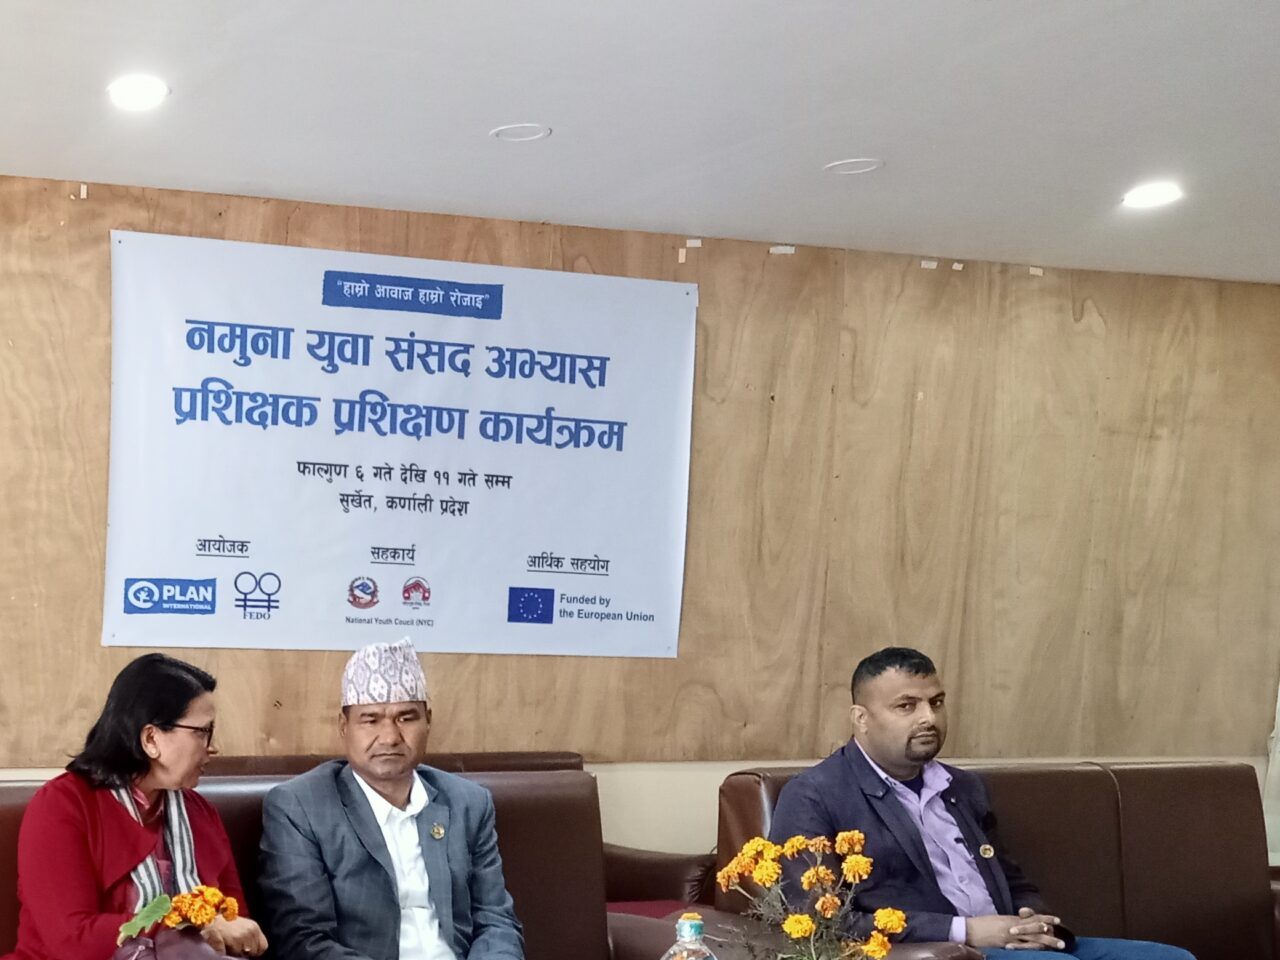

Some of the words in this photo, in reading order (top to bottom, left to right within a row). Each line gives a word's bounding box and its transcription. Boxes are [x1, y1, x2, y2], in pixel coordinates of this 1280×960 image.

[374, 284, 414, 301] आवाज
[419, 287, 445, 305] हाम्रो
[185, 319, 295, 367] नमुना
[306, 329, 374, 374] युवा
[385, 331, 475, 378] संसद
[485, 345, 610, 389] अभ्यास
[172, 376, 321, 430] प्रशिक्षक
[332, 389, 469, 441] प्रशिक्षण
[479, 406, 628, 452] कार्यक्रम
[297, 461, 349, 484] फाल्गुण
[355, 464, 364, 482] ६
[372, 462, 394, 481] गते
[400, 463, 427, 484] देखि
[433, 469, 450, 486] ११
[457, 468, 478, 487] गते
[484, 473, 513, 490] सम्म
[385, 493, 434, 515] कर्णाली
[440, 496, 470, 517] प्रदेश
[196, 535, 251, 554] आयोजक
[370, 544, 416, 562] सहकार्य
[527, 552, 565, 570] आर्थिक
[570, 555, 610, 573] सहयोग
[163, 584, 213, 602] PLAN
[560, 593, 597, 606] Funded
[599, 595, 611, 608] by
[162, 603, 212, 611] INTERNATIONAL
[243, 611, 271, 621] FEDO
[559, 608, 574, 619] the
[577, 609, 623, 623] European
[626, 611, 655, 622] Union
[345, 616, 373, 625] National
[375, 617, 393, 626] Youth
[416, 619, 434, 628] (NYC)
